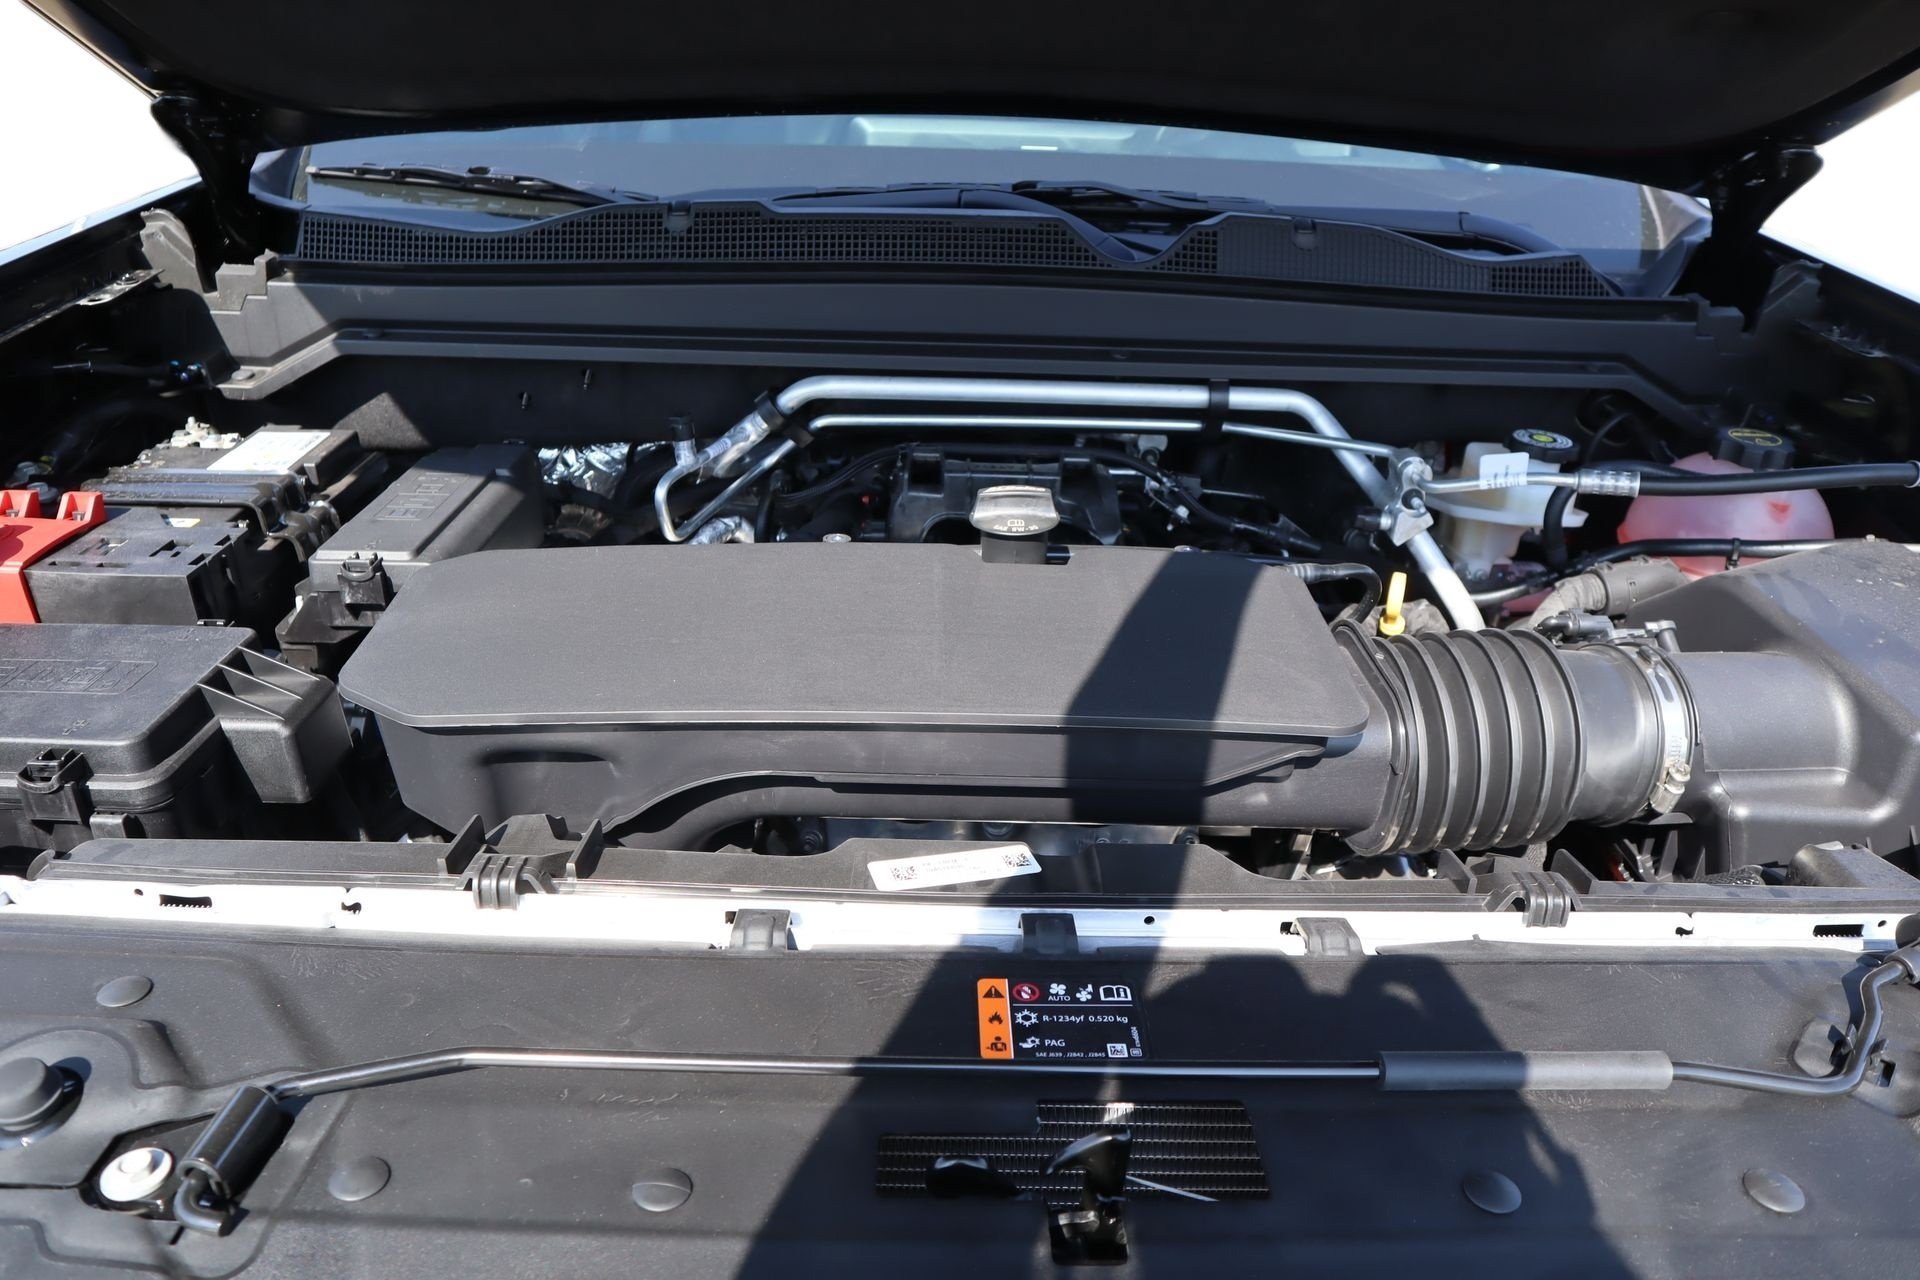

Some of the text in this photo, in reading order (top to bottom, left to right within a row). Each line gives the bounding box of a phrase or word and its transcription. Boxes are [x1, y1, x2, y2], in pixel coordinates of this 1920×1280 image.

[1042, 1015, 1085, 1023] R-1234yf
[1116, 1015, 1129, 1024] kg
[1044, 1039, 1066, 1047] PAG
